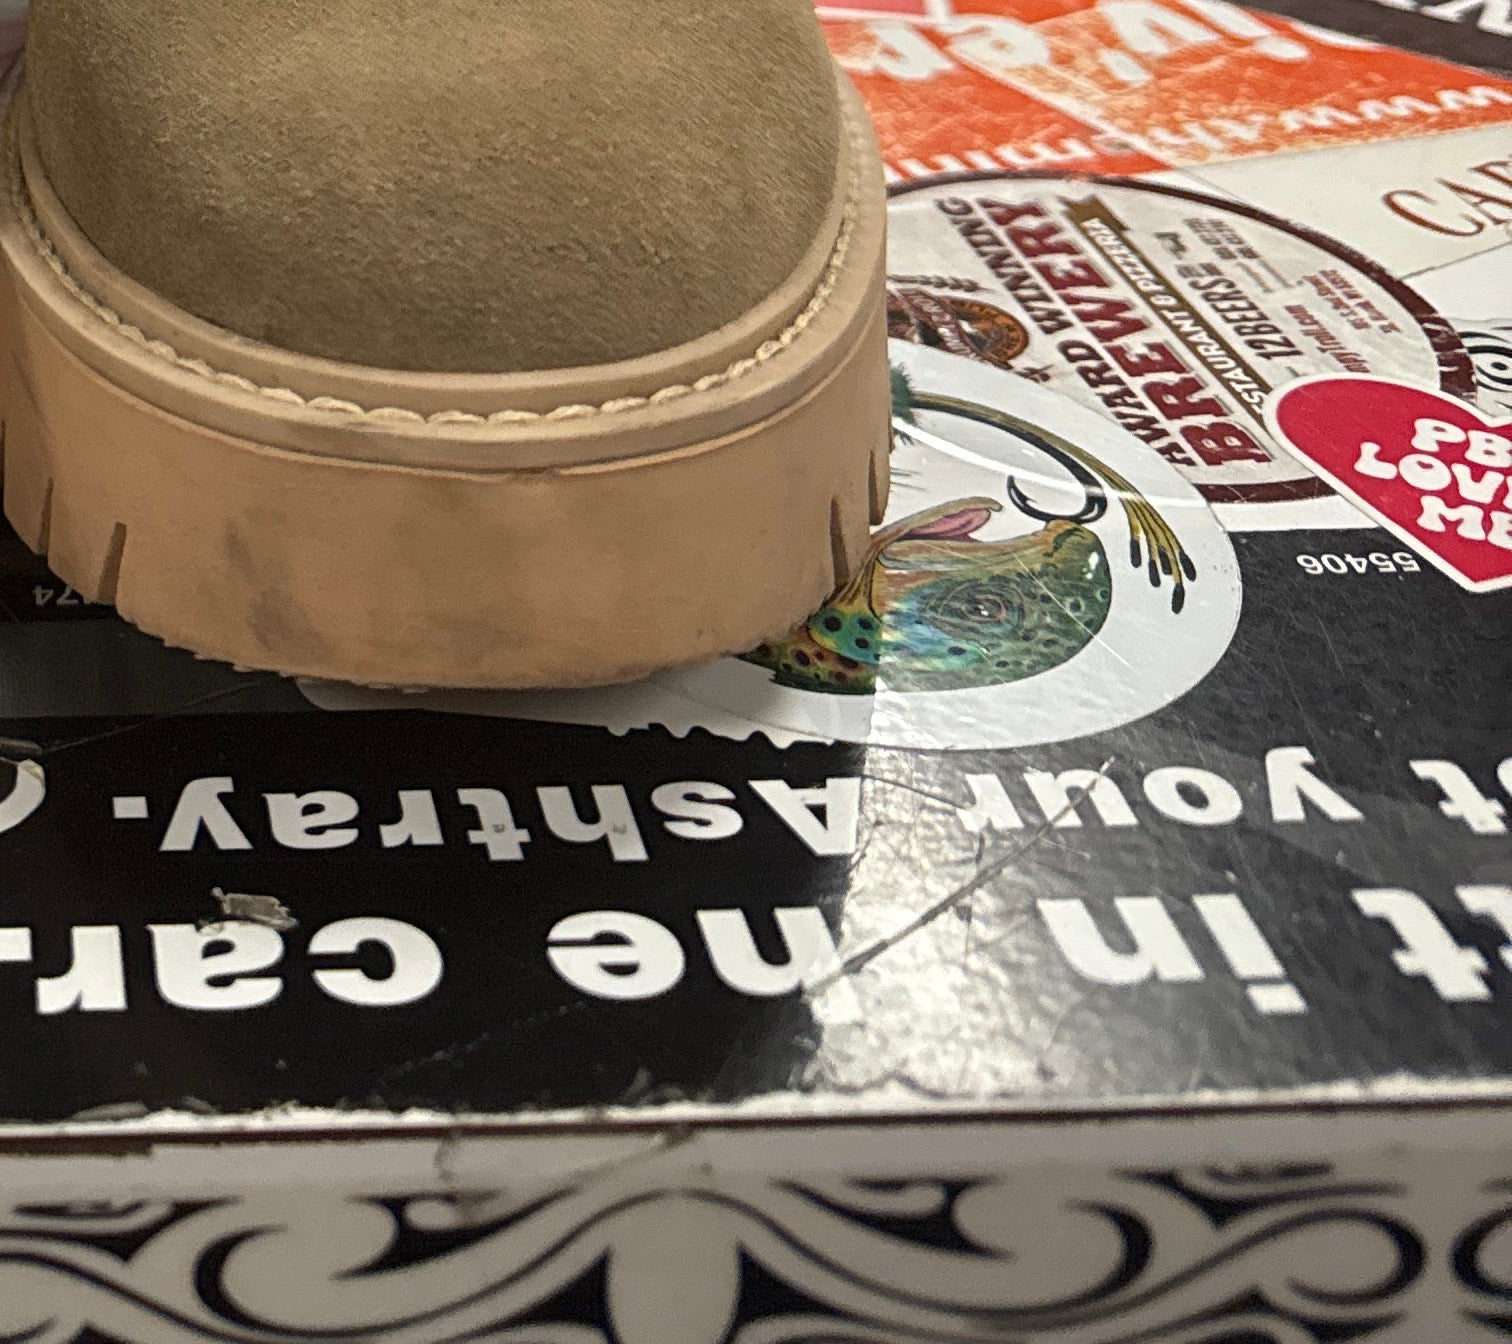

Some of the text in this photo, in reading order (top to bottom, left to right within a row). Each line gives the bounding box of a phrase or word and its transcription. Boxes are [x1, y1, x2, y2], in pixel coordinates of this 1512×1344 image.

[934, 196, 1074, 335] WINNING
[976, 197, 1277, 466] BREWERY
[1056, 339, 1197, 467] AWARD
[1354, 441, 1512, 509] LOV
[1296, 551, 1422, 575] 55406
[112, 775, 863, 862] Ashtray.
[957, 745, 1364, 833] your
[1035, 892, 1307, 1017] in
